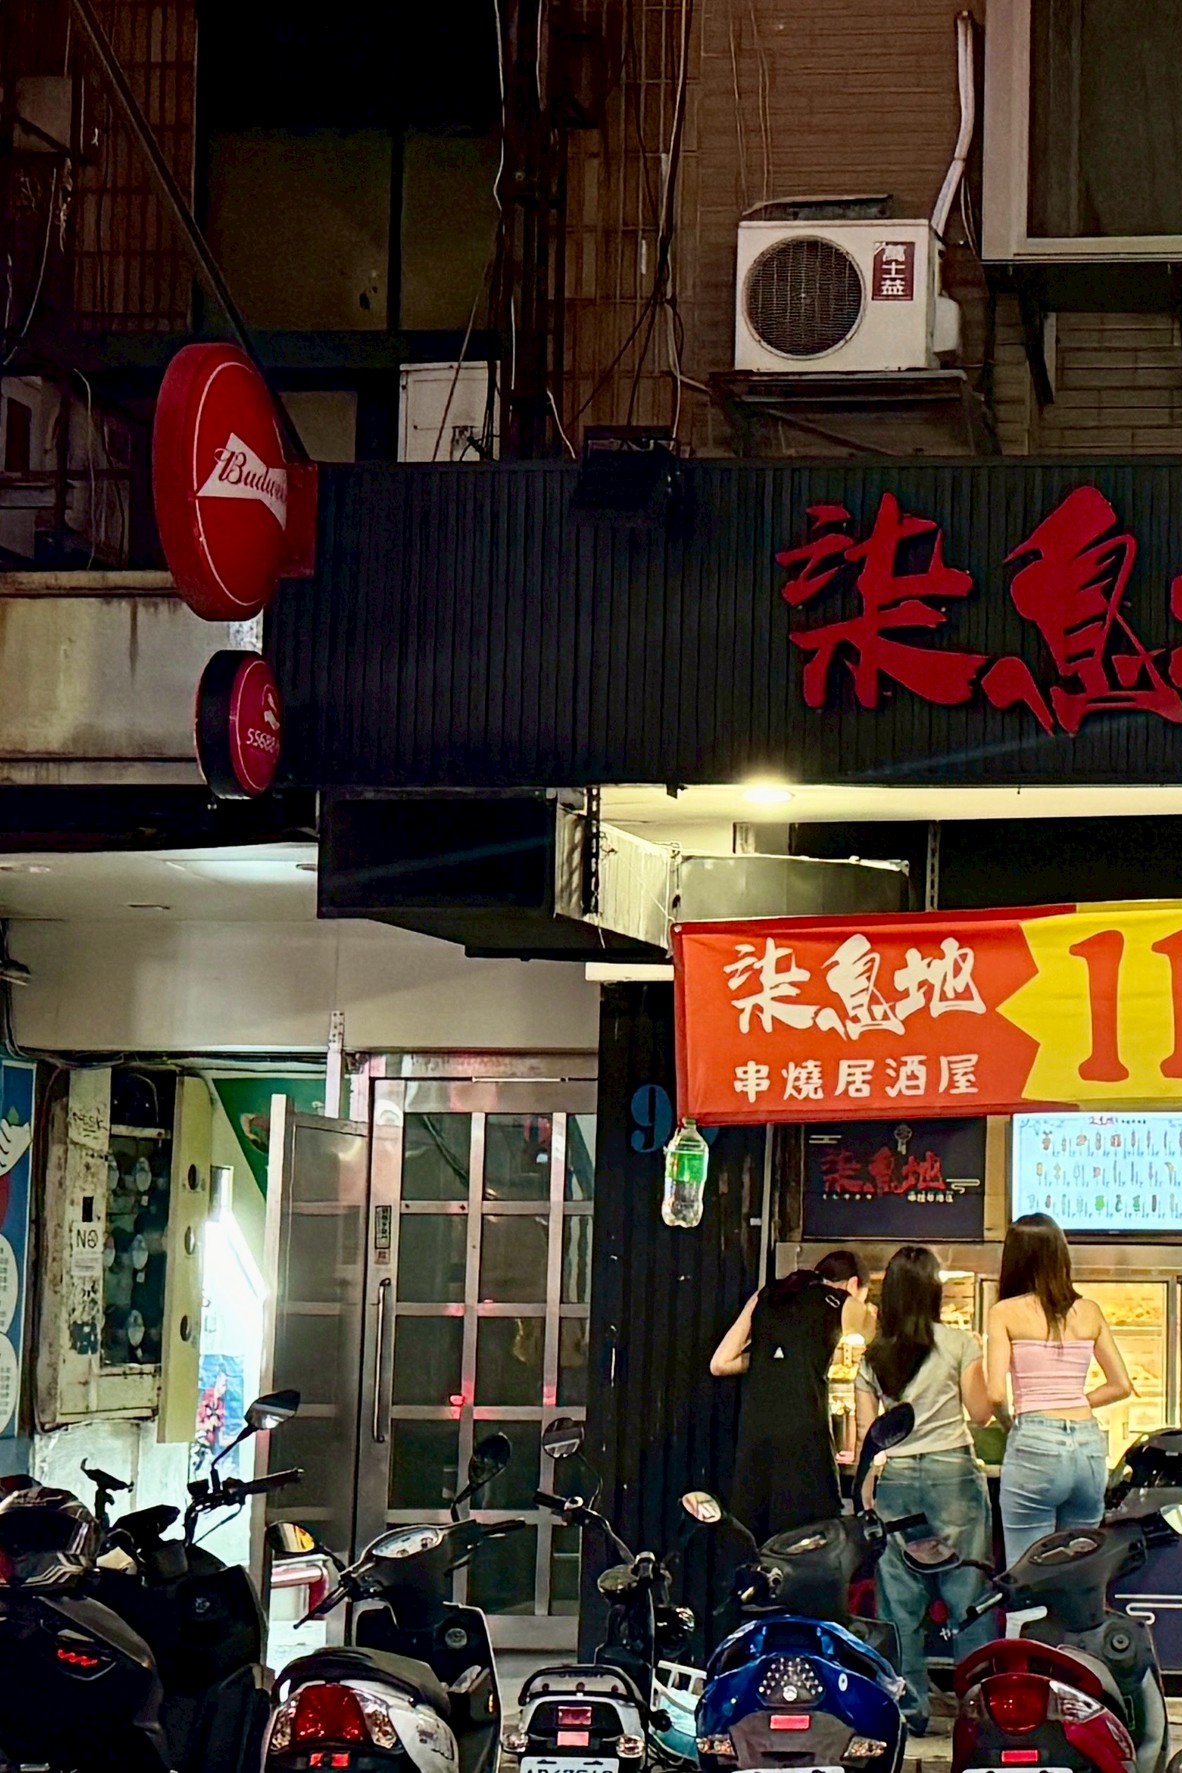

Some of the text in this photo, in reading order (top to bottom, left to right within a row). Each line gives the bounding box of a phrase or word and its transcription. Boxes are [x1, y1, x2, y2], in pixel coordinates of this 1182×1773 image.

[723, 932, 988, 1041] 柒息地
[732, 1052, 980, 1103] 串燒居酒屋
